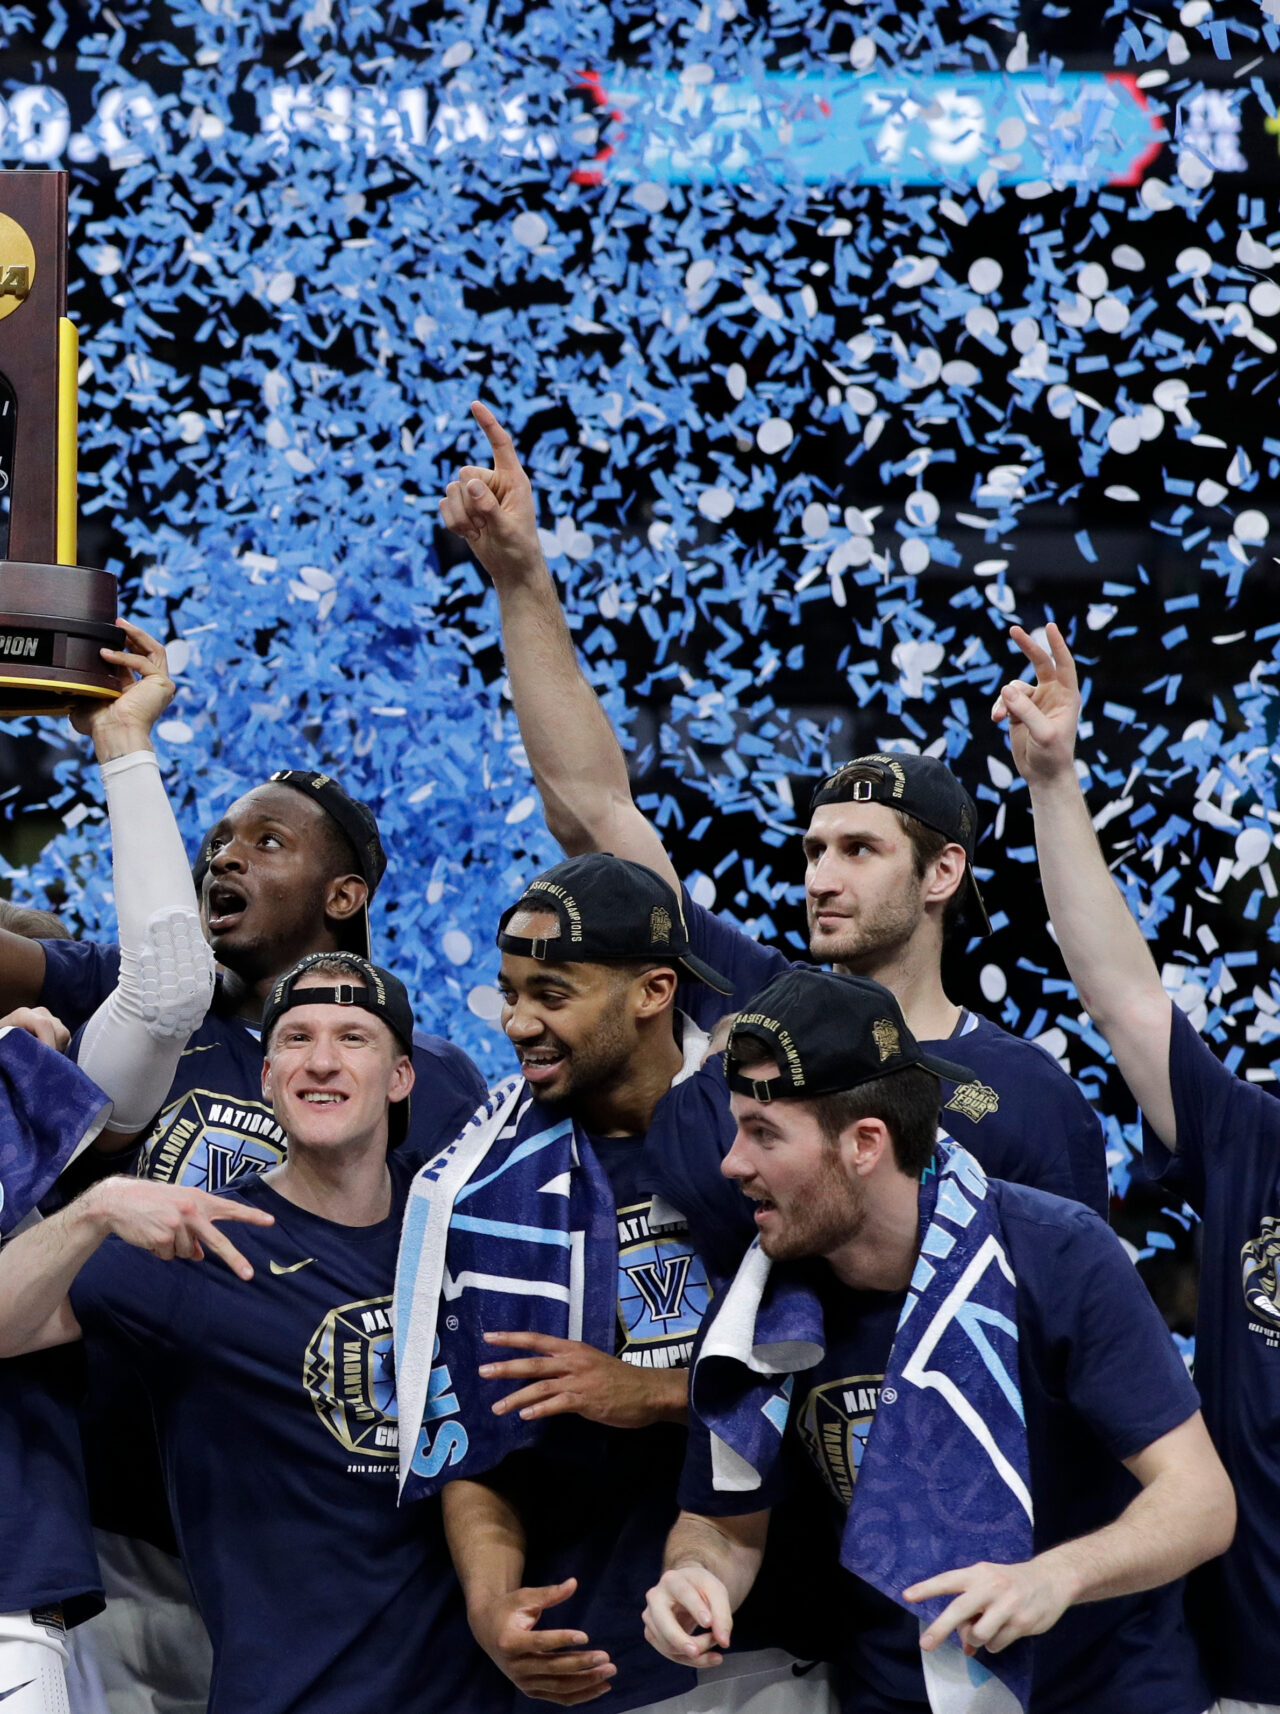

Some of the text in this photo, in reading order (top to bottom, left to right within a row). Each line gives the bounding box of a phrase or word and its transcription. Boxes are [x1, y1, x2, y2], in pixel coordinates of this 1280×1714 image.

[562, 896, 583, 942] CHAMPIONS
[778, 1030, 806, 1087] CHAMPIONS
[152, 1117, 199, 1183] LLANOVA
[626, 1255, 692, 1322] V
